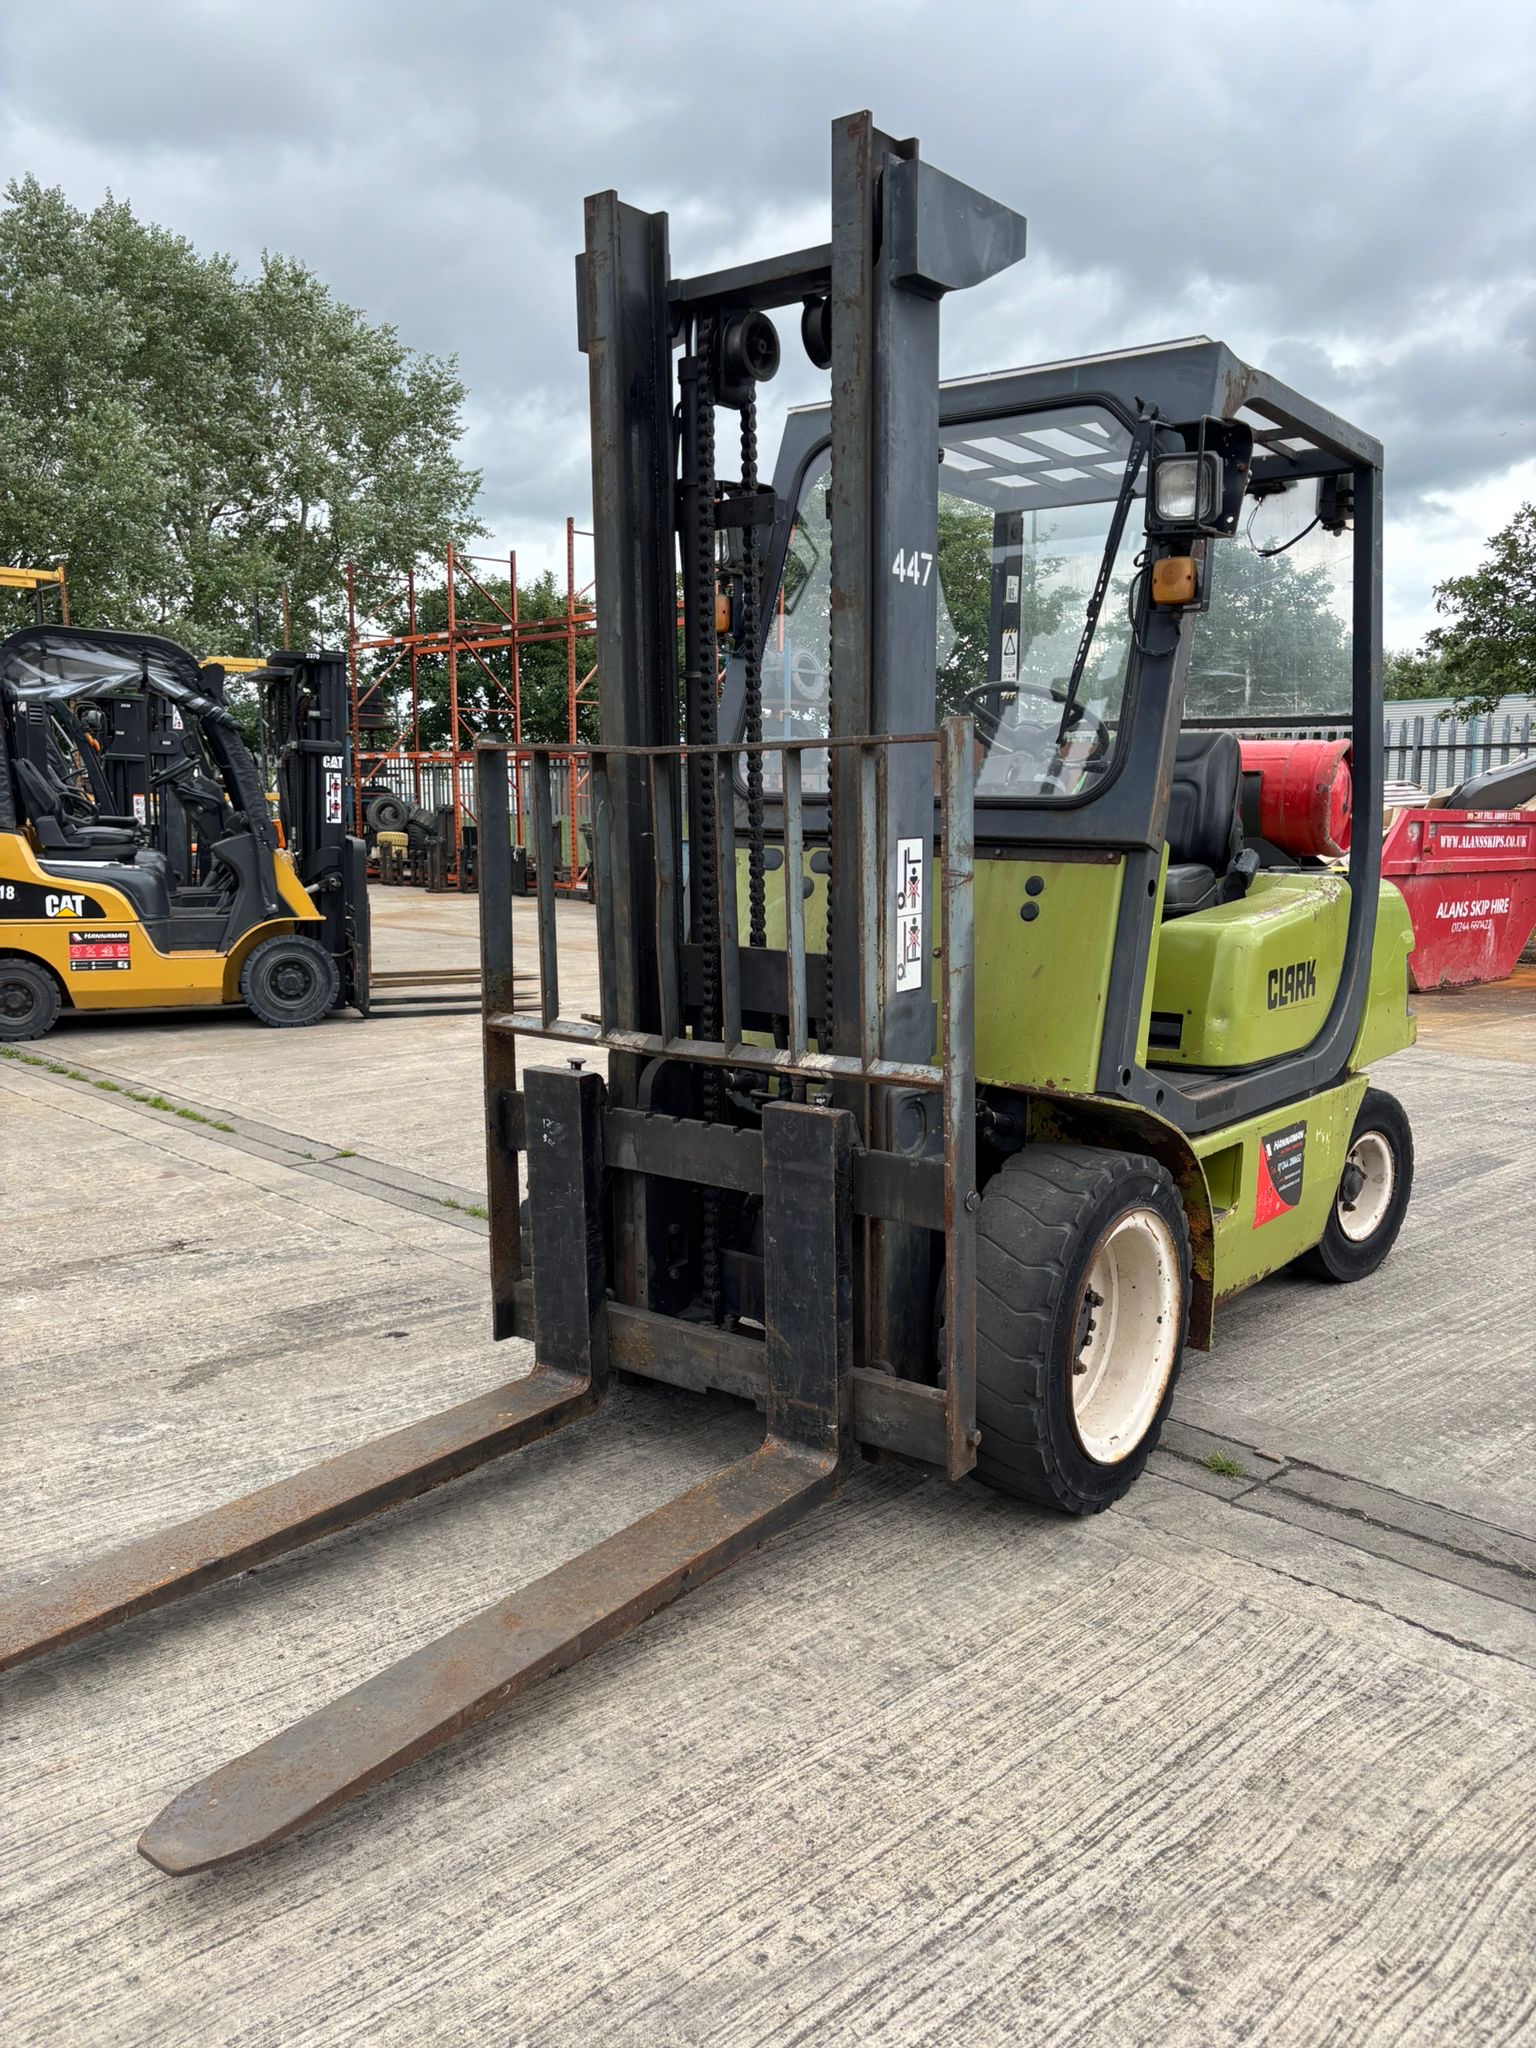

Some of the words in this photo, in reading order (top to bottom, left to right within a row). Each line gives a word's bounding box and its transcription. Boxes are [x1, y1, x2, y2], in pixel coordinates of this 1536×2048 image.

[892, 548, 933, 586] 447
[322, 755, 344, 769] CAT
[45, 894, 85, 917] CAT
[1436, 901, 1469, 919] ALANS
[1470, 900, 1490, 917] SKIP
[1490, 898, 1509, 914] HIRE
[1268, 959, 1316, 1010] CLARK
